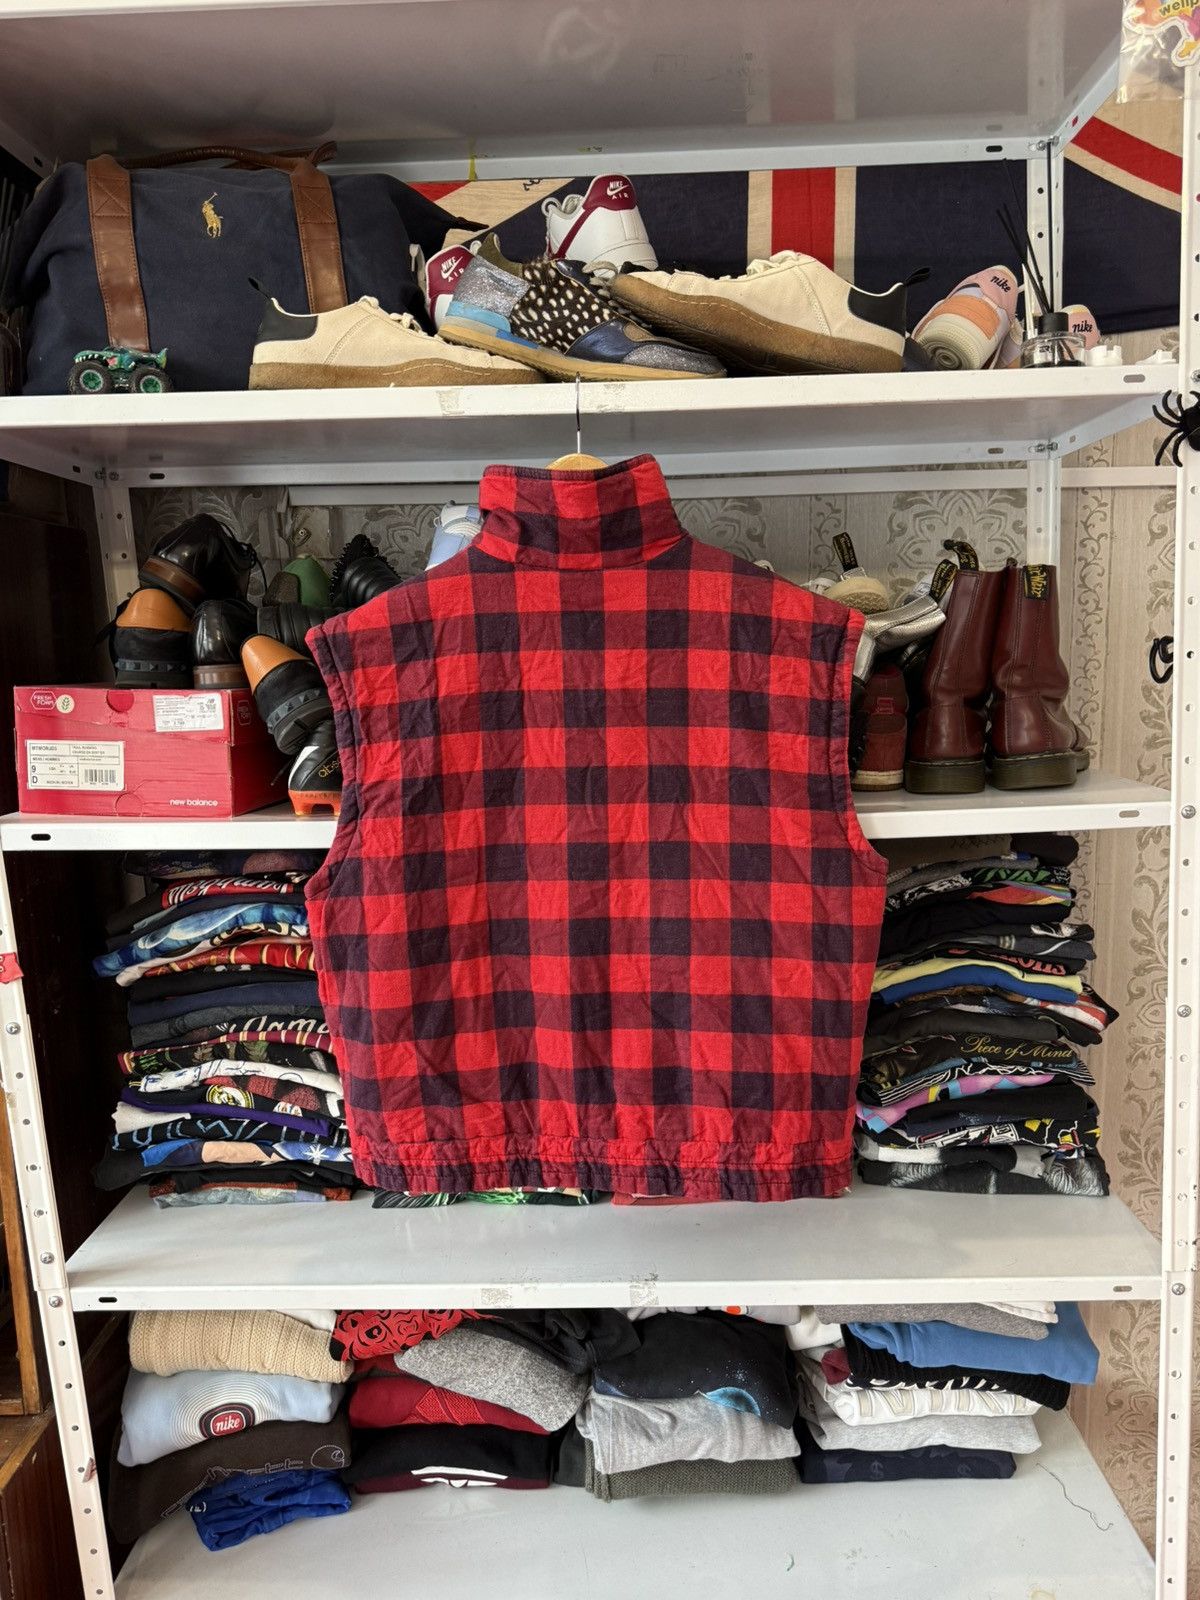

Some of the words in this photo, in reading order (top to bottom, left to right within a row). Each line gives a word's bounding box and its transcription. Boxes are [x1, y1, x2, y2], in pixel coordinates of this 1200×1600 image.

[609, 180, 624, 189] NIKE
[611, 192, 629, 200] AIR
[441, 255, 456, 273] NIKE
[447, 267, 465, 283] AIR
[990, 275, 1011, 293] nike
[1072, 320, 1093, 333] nike
[31, 765, 37, 773] 9
[32, 776, 38, 784] D
[186, 798, 218, 807] balance
[961, 1035, 1002, 1053] Piece
[1004, 1043, 1027, 1061] of
[1020, 1046, 1072, 1058] Mind
[215, 1415, 241, 1432] nike
